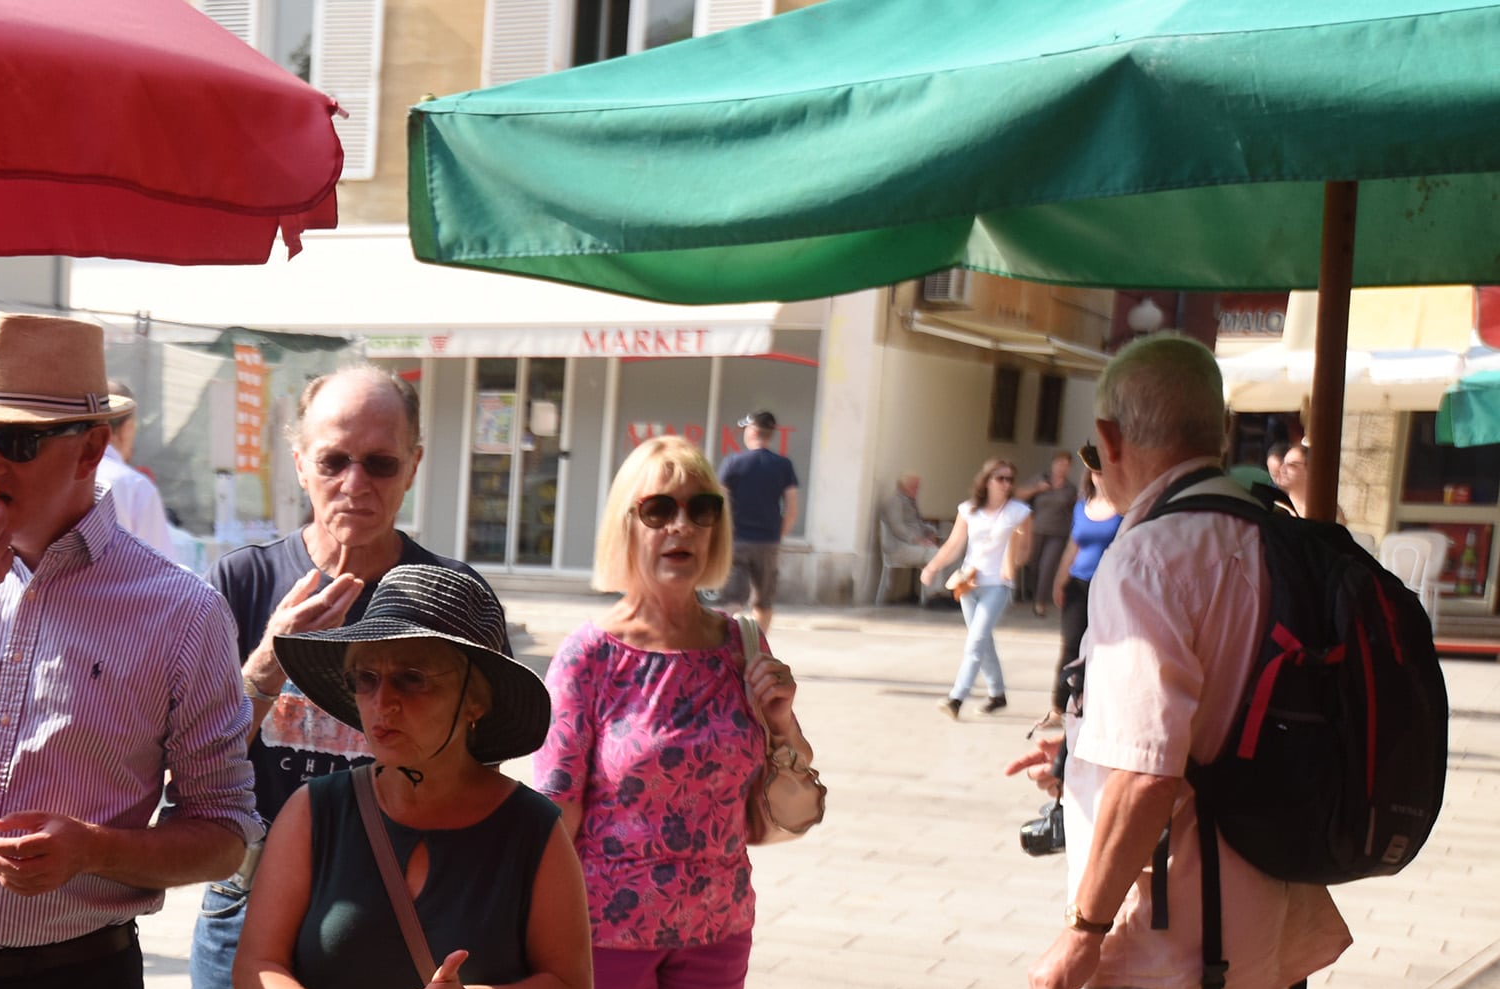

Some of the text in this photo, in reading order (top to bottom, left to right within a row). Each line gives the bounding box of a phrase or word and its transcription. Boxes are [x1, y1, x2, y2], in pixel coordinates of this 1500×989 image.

[580, 328, 711, 353] MARKET
[623, 421, 796, 457] MRKT
[280, 757, 354, 774] CHI
